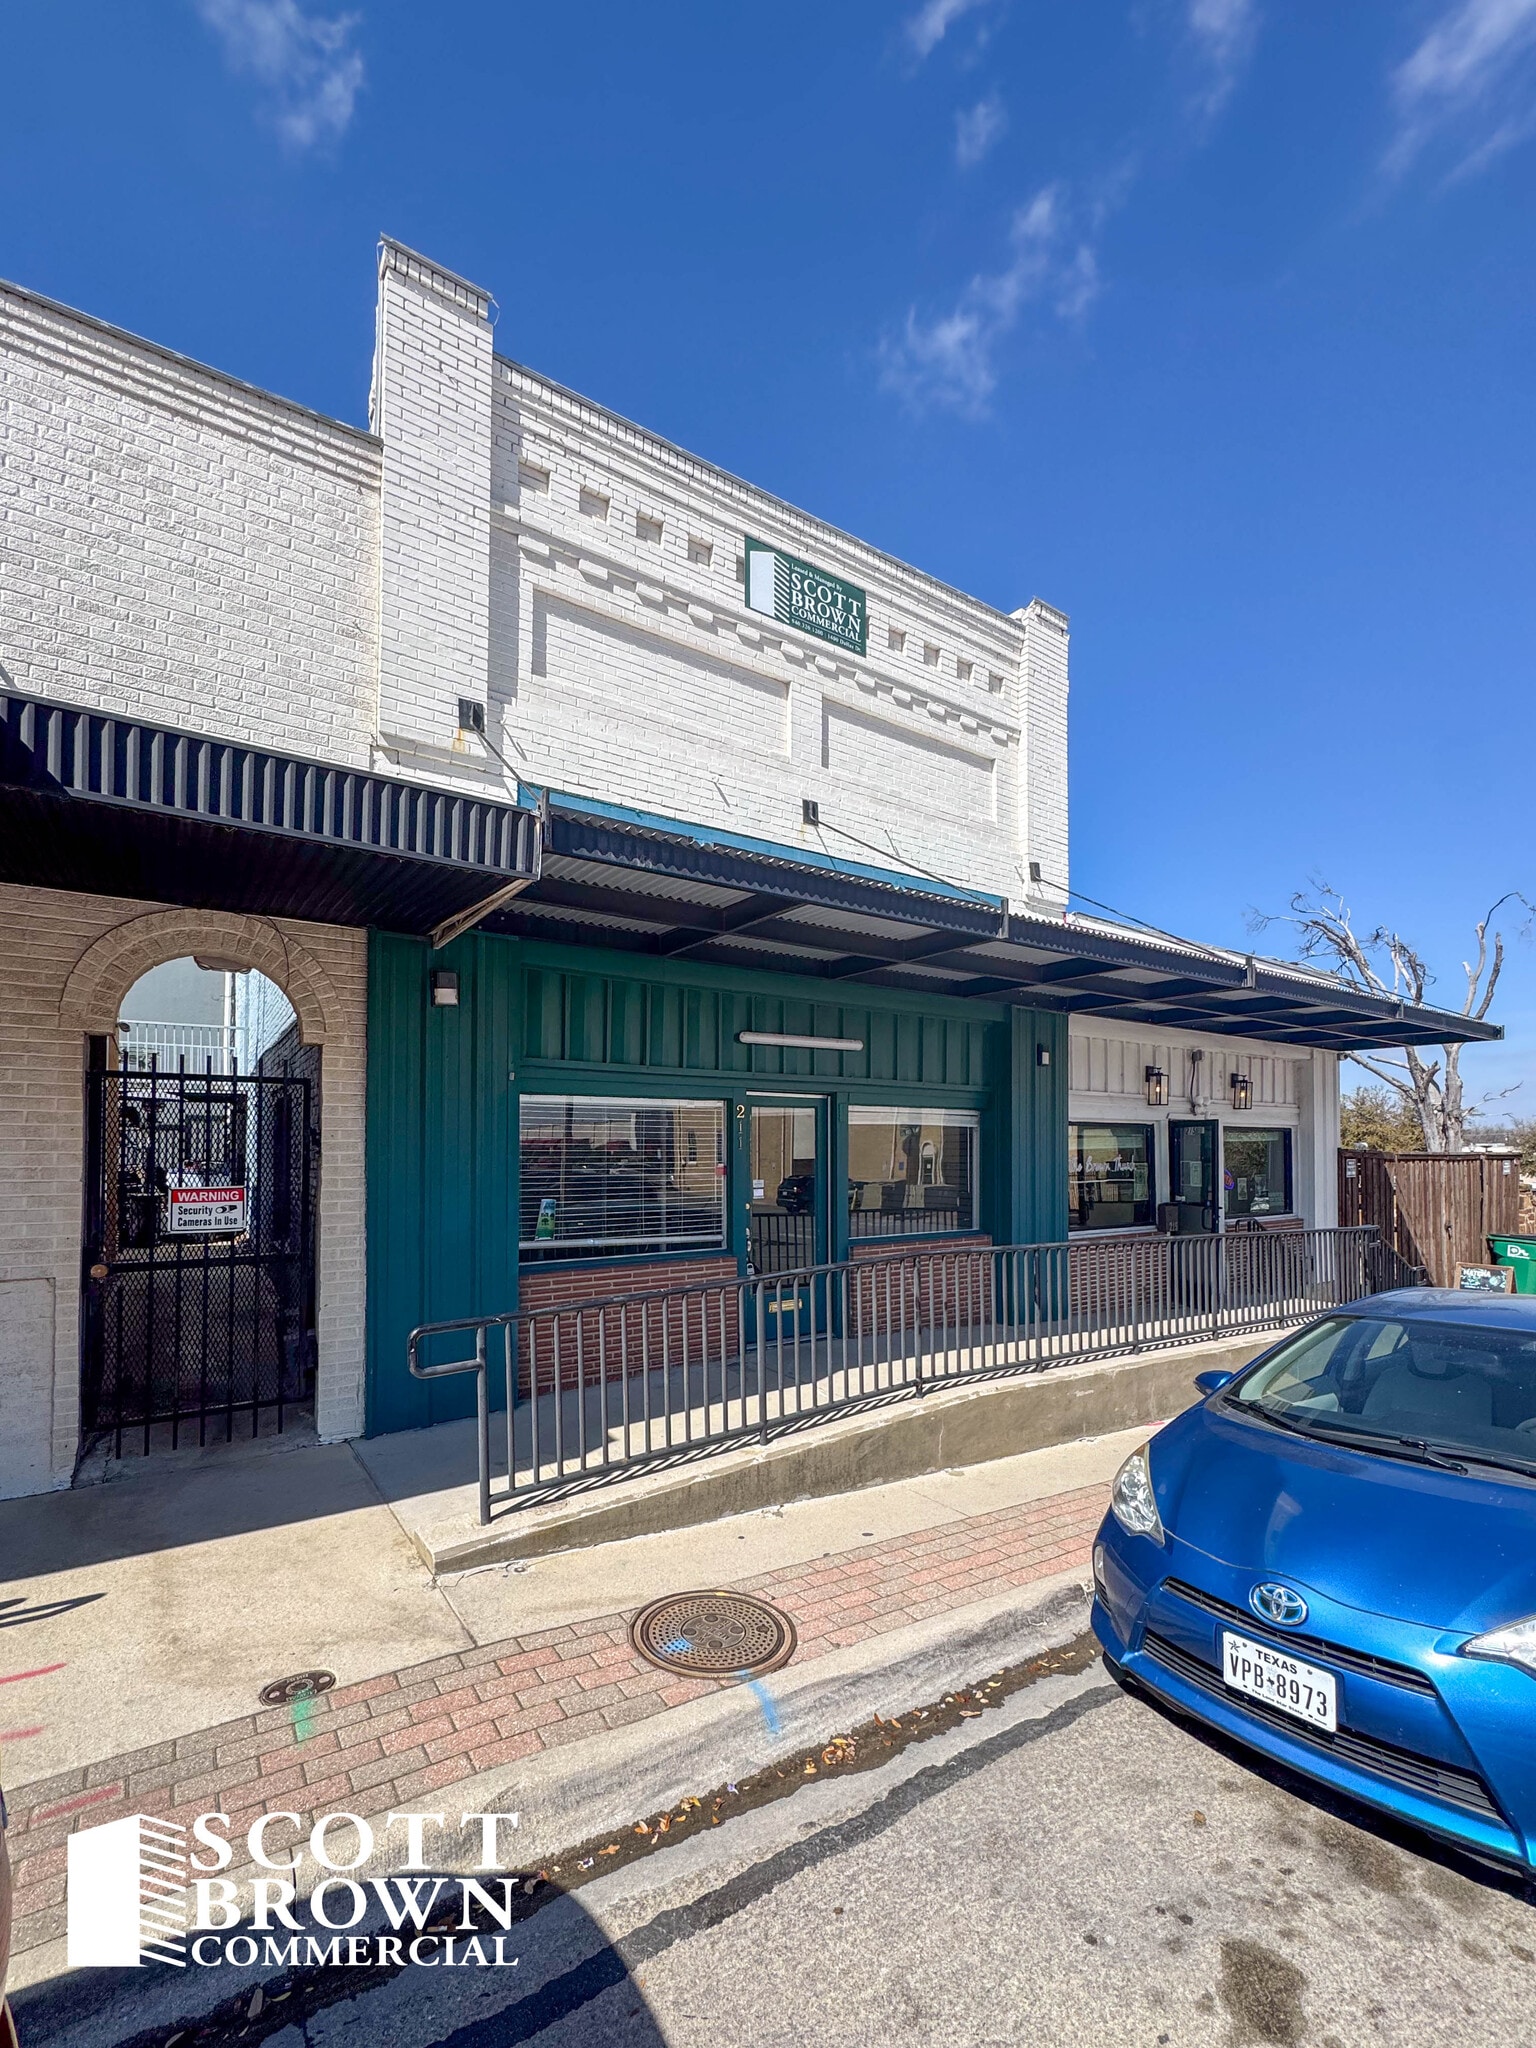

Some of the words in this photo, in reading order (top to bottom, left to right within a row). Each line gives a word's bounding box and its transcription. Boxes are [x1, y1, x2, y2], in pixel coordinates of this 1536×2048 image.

[791, 573, 861, 617] SCOTT
[791, 589, 861, 633] BROWN
[791, 606, 861, 643] COMMERCIAL
[178, 1190, 240, 1202] WARNING
[178, 1204, 213, 1216] Security
[177, 1216, 212, 1227] Cameras
[214, 1216, 222, 1226] In
[224, 1215, 238, 1225] Use
[1255, 1648, 1298, 1675] TEXAS
[1229, 1653, 1264, 1689] VPB
[1276, 1673, 1328, 1717] 8973
